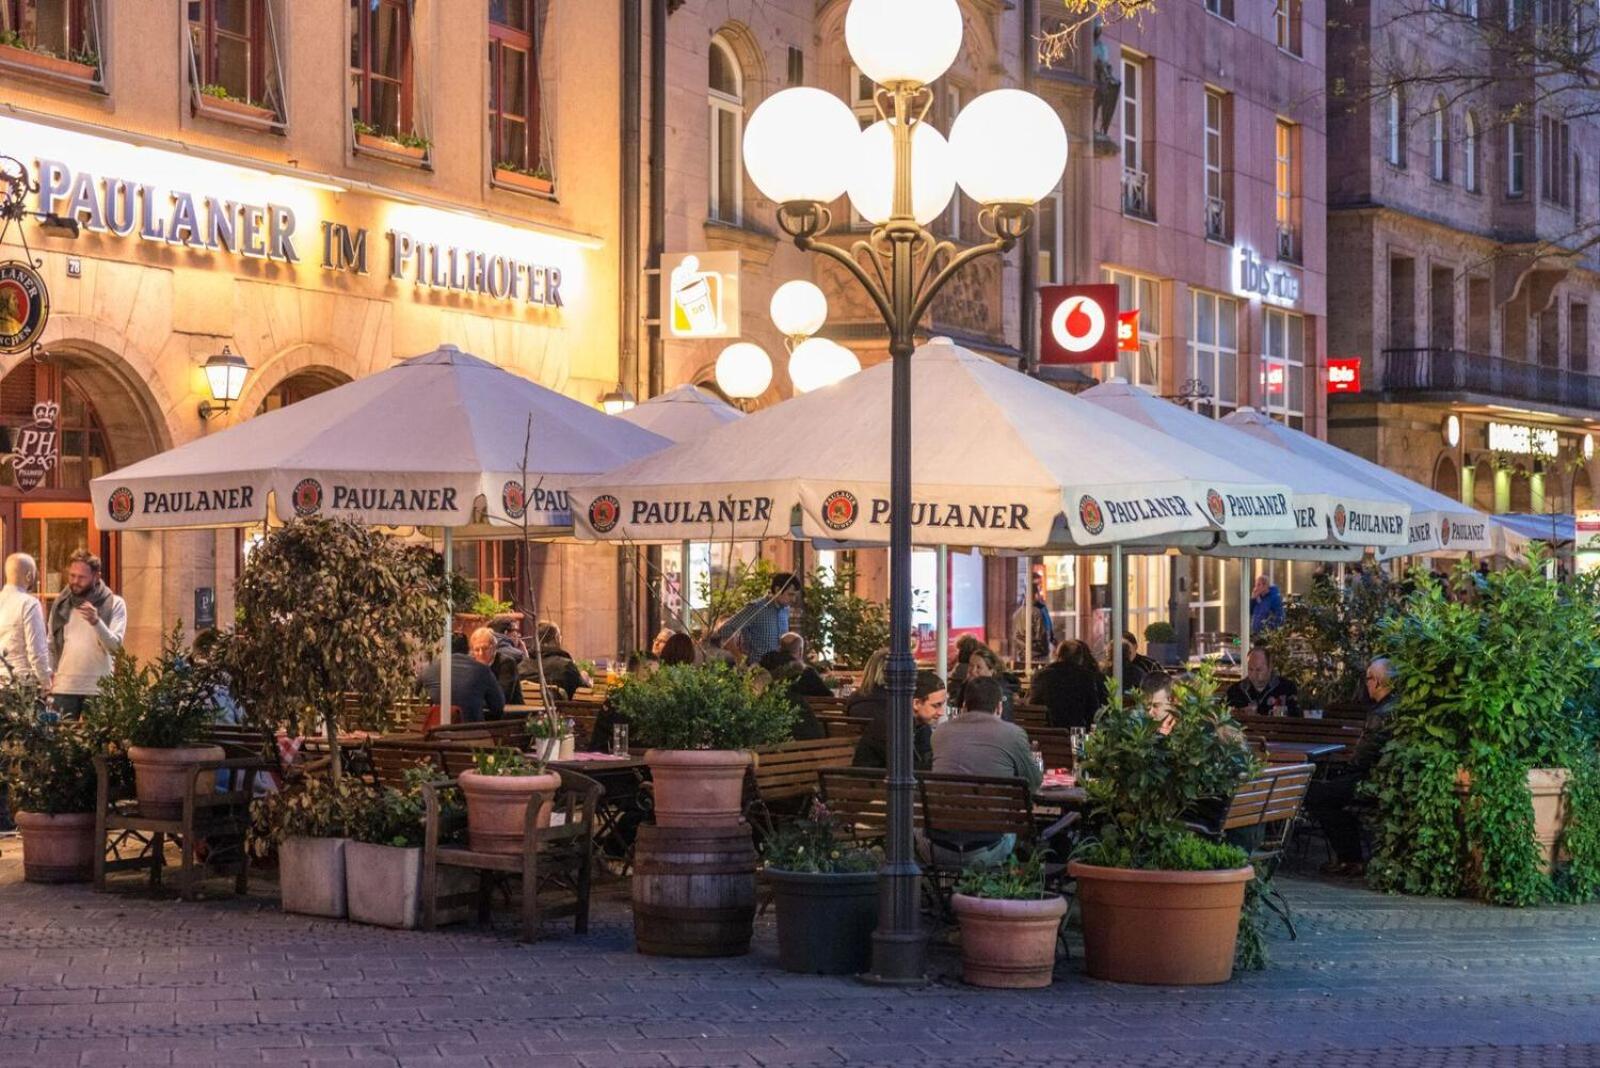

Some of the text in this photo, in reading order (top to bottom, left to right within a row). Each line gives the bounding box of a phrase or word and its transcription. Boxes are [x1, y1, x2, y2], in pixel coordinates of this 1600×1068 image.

[34, 157, 564, 308] PAULANER IM PILLHOFER
[68, 260, 81, 274] 78
[20, 430, 56, 456] PH
[142, 485, 254, 514] PAULANER
[332, 485, 458, 511] PAULANER
[631, 497, 771, 524] PAULANER
[1104, 495, 1192, 524] PAULANER
[1226, 493, 1288, 517] PAULANER
[870, 498, 1031, 530] PULANER
[1349, 510, 1404, 535] PAULANER
